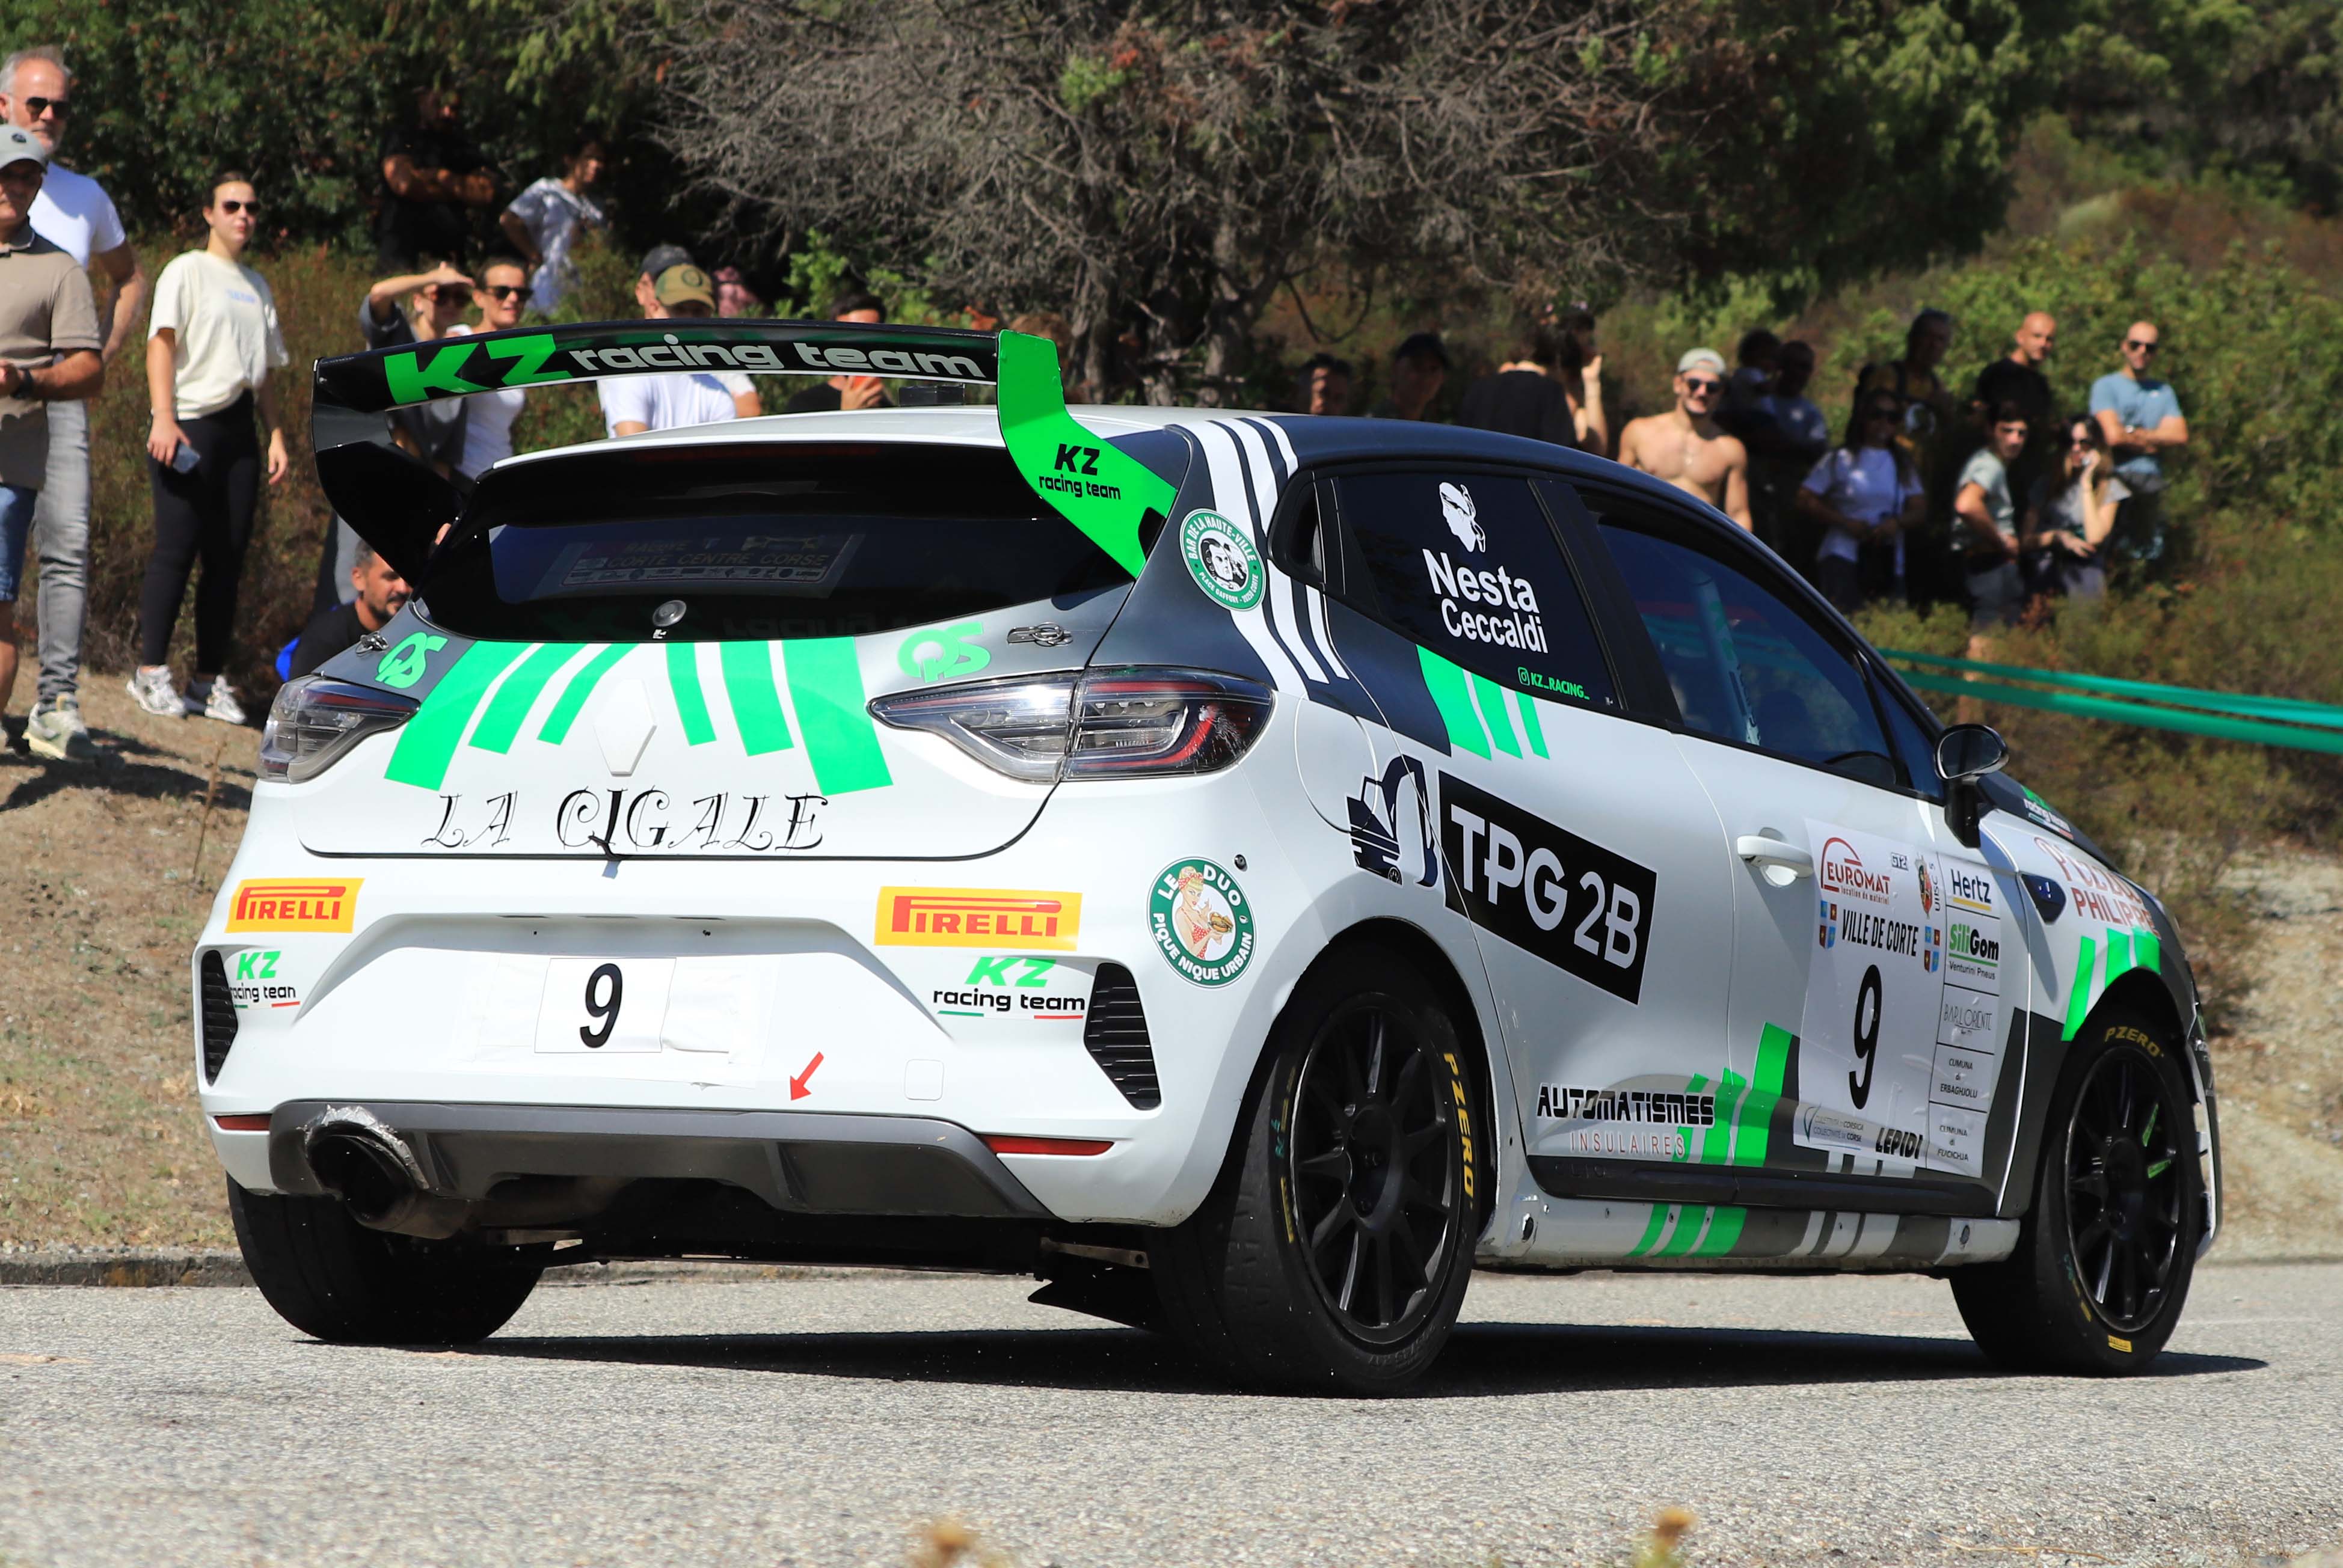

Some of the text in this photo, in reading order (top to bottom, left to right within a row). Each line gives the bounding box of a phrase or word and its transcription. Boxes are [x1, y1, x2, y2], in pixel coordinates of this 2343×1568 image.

[384, 333, 986, 405] KZ racing team
[1054, 443, 1100, 476] KZ
[1039, 473, 1121, 500] racing team
[1186, 516, 1256, 562] BAR DE LA HAUTE-VILLE
[678, 552, 752, 565] CENTRE
[760, 552, 829, 566] CORSE
[1199, 572, 1216, 593] PLACE
[1422, 548, 1540, 613] Nesta
[1442, 598, 1549, 654] Ceccaldi
[420, 785, 828, 852] LA CIGALE
[1158, 864, 1241, 906] LE DUO
[1451, 803, 1641, 969] TPG 2B
[1827, 862, 1890, 895] EUROMAT
[1951, 869, 1992, 904] Hertz
[236, 886, 346, 920] PIRELLI
[891, 895, 1062, 937] PIRELLI
[2071, 887, 2161, 940] PHILIPPE
[1153, 913, 1252, 981] PIQUE NIQUE URBAIN
[1842, 909, 1918, 957] VILLE DE CORTE
[1949, 923, 1999, 961] SiliGom
[236, 951, 281, 980] KZ
[964, 957, 1057, 988] KZ
[1949, 961, 1995, 980] Venturini Pneus
[580, 963, 623, 1049] 9
[933, 988, 1086, 1012] racing team
[1849, 964, 1882, 1109] 9
[1948, 1058, 1973, 1070] CUMUNA
[1537, 1083, 1715, 1125] AUTOMATISMES
[1571, 1133, 1684, 1156] INSULAIRES
[1876, 1127, 1923, 1159] LEPIDI
